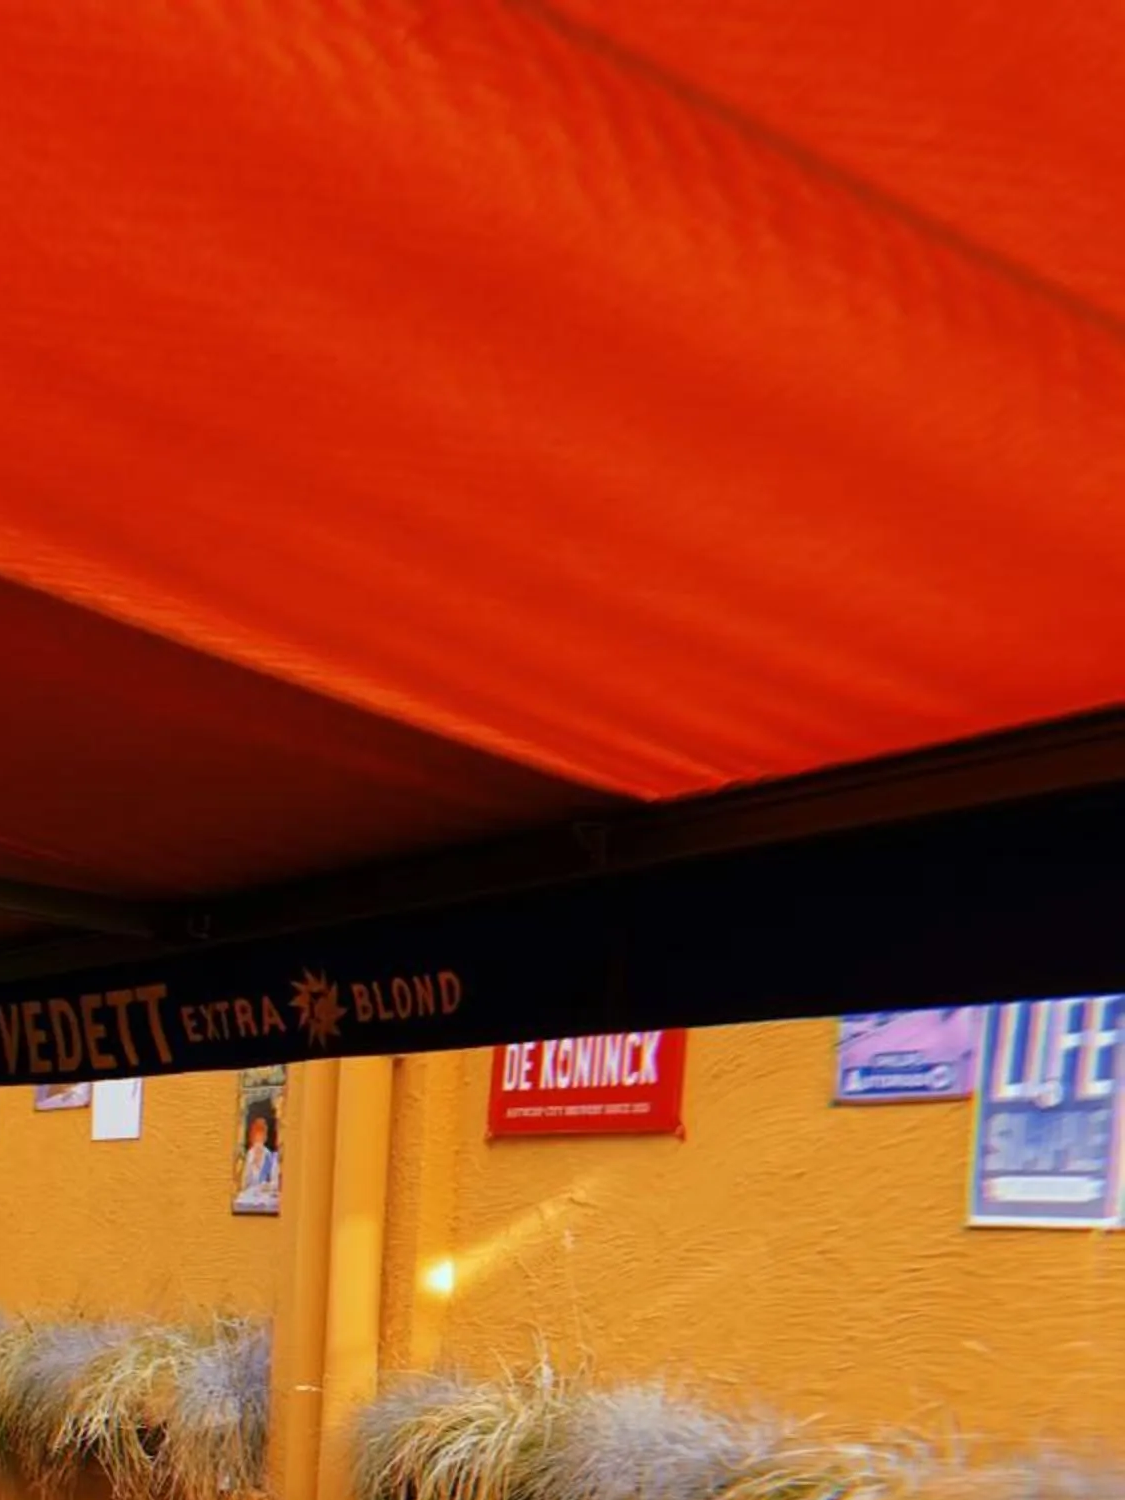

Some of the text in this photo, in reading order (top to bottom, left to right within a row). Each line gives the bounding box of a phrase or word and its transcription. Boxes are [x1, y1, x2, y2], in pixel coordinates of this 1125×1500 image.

[180, 995, 287, 1042] EXTRA
[351, 971, 461, 1023] BLOND
[502, 1031, 663, 1091] DE KONINCK
